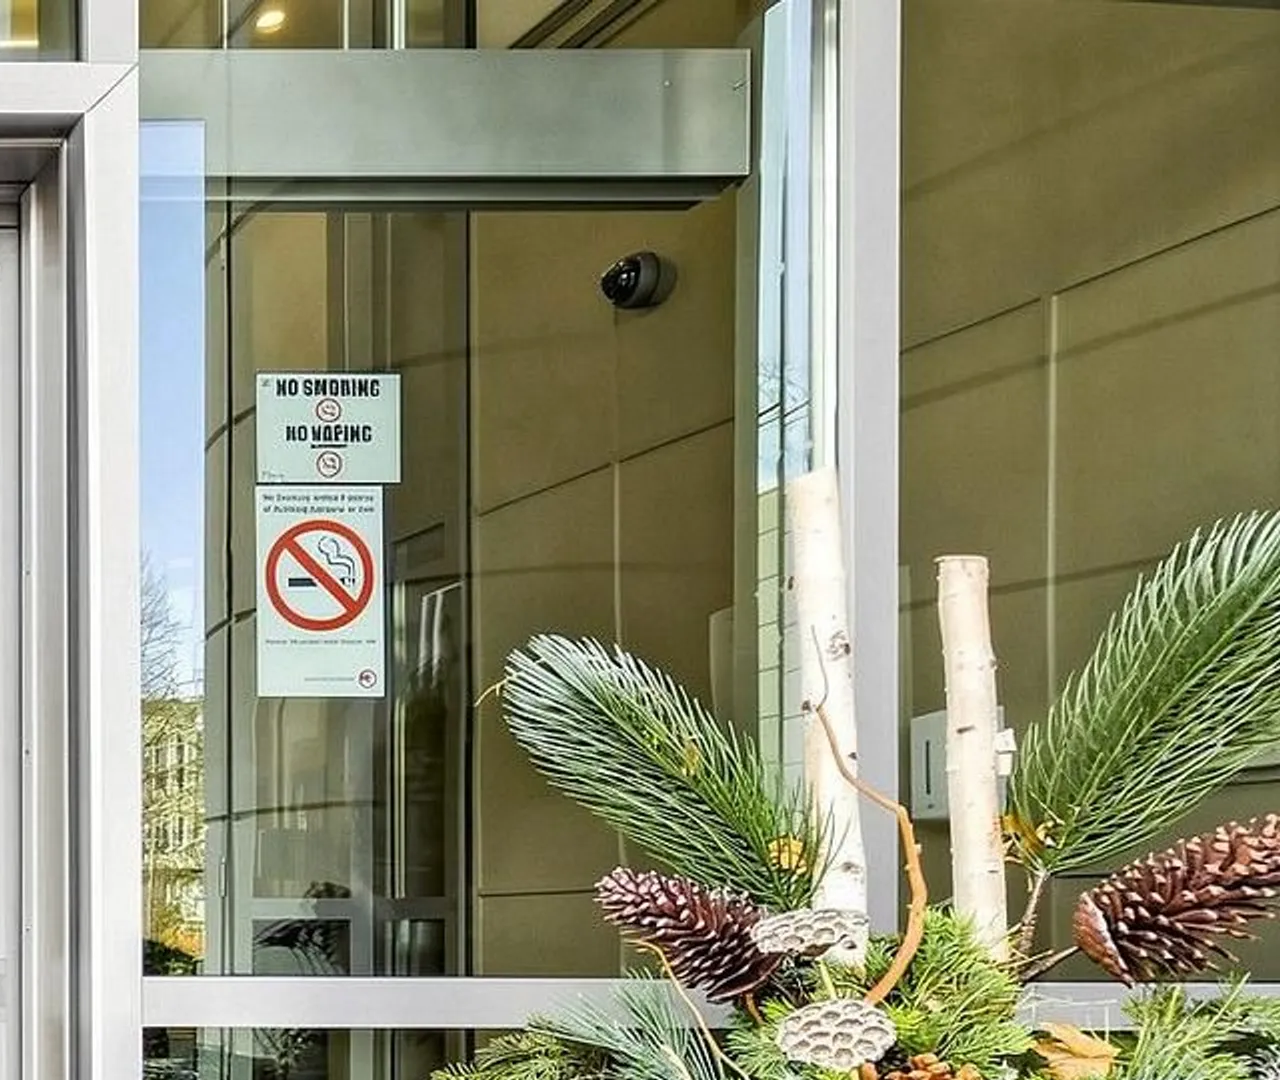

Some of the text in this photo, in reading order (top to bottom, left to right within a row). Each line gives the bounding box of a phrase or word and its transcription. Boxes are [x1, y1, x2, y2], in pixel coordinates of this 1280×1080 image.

[276, 378, 380, 397] NO SMOKING
[285, 424, 372, 443] NO VAPING
